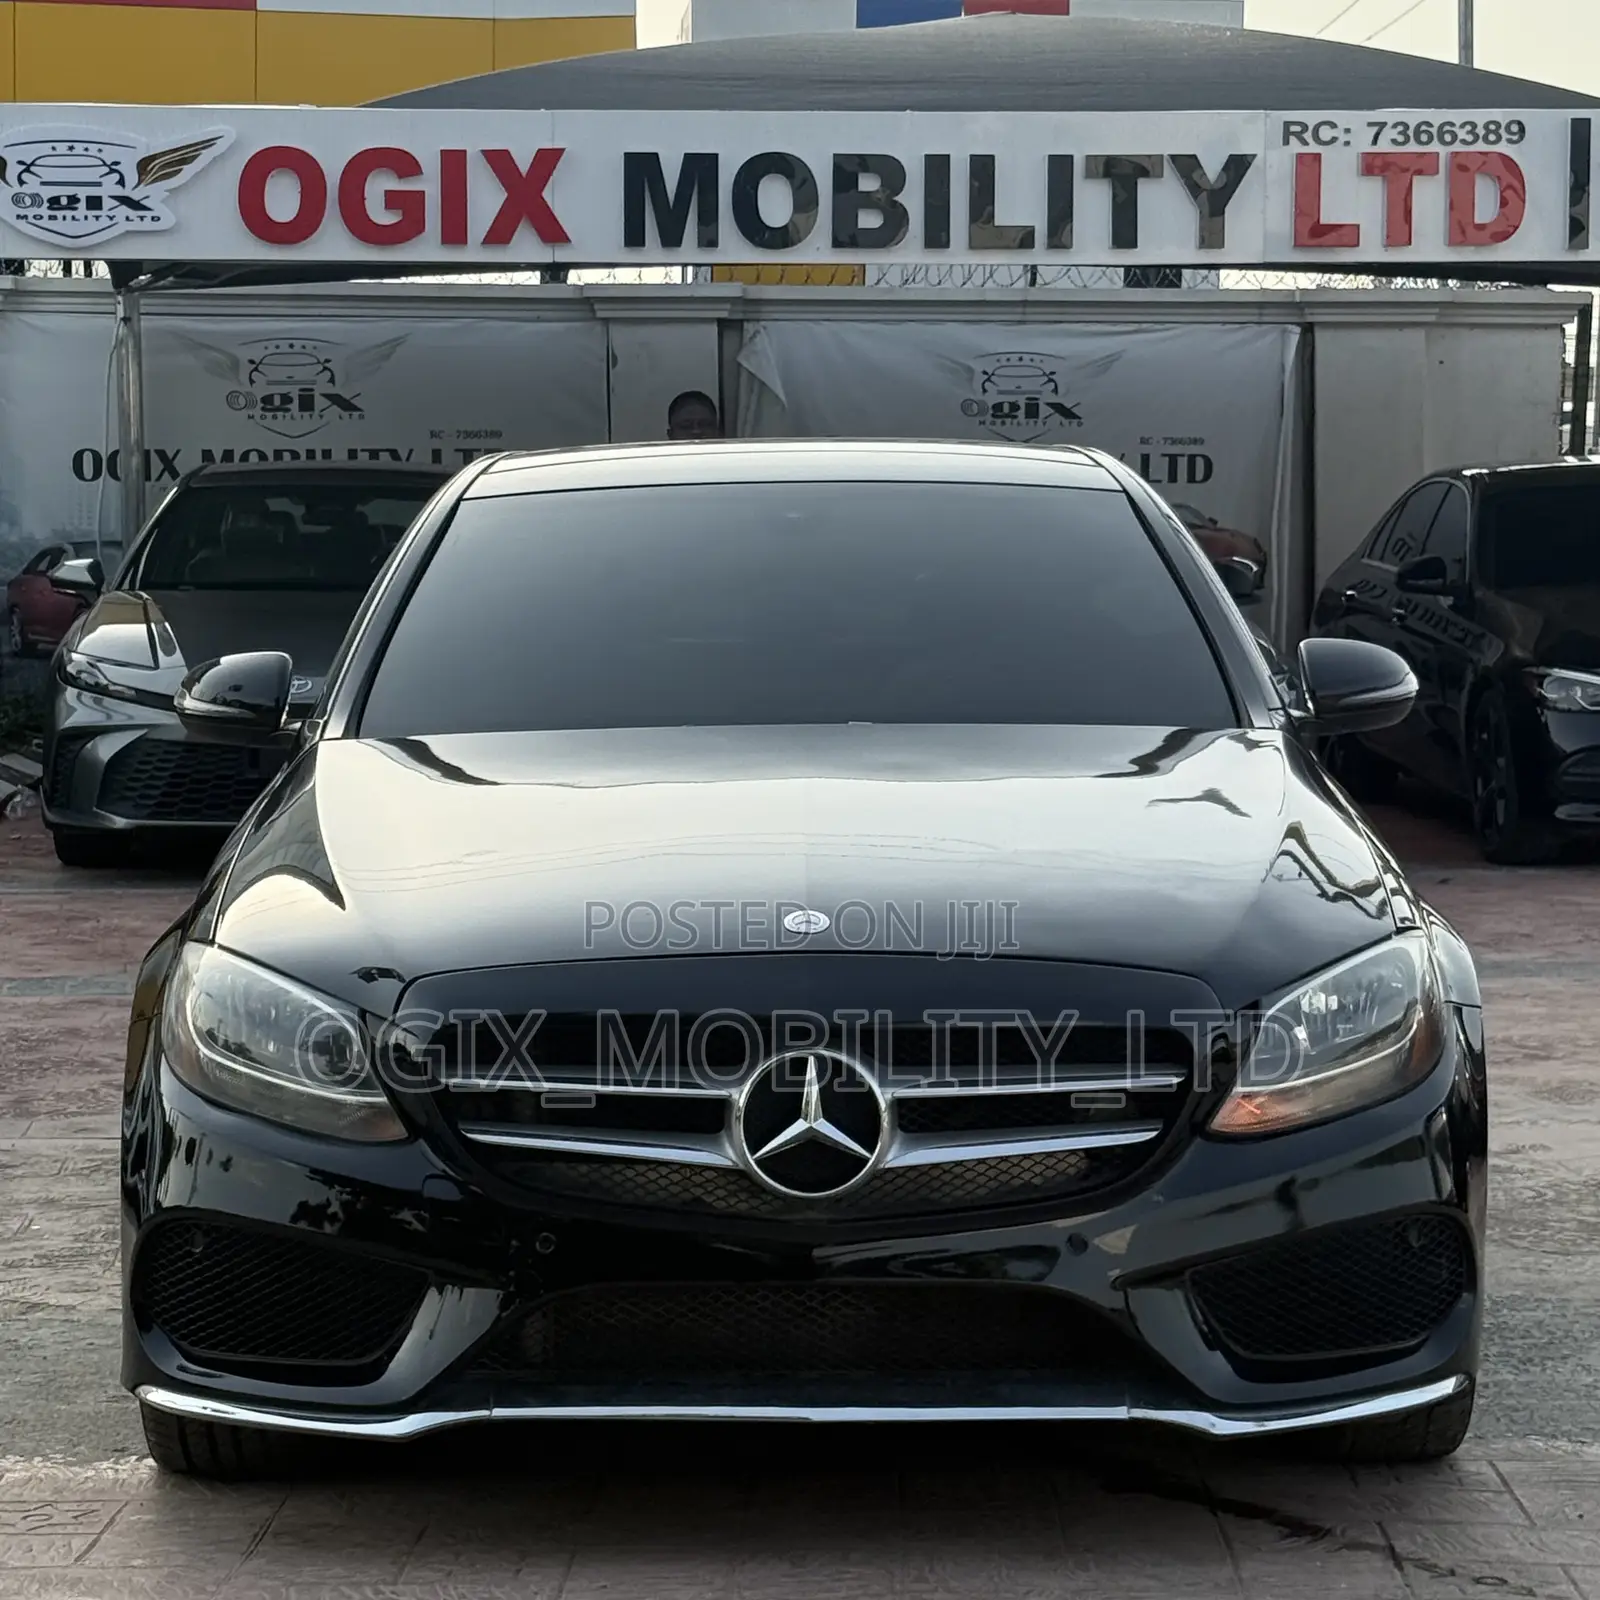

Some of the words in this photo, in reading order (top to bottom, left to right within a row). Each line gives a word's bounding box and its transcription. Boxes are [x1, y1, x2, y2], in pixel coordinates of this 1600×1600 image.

[1282, 120, 1351, 146] RC:
[1366, 119, 1526, 146] 7366389
[237, 145, 572, 246] OGIX
[622, 152, 1258, 250] MOBILITY
[1293, 151, 1527, 248] LTD
[16, 214, 117, 222] MOBILITY
[429, 429, 444, 440] RC
[1140, 453, 1213, 484] LTD
